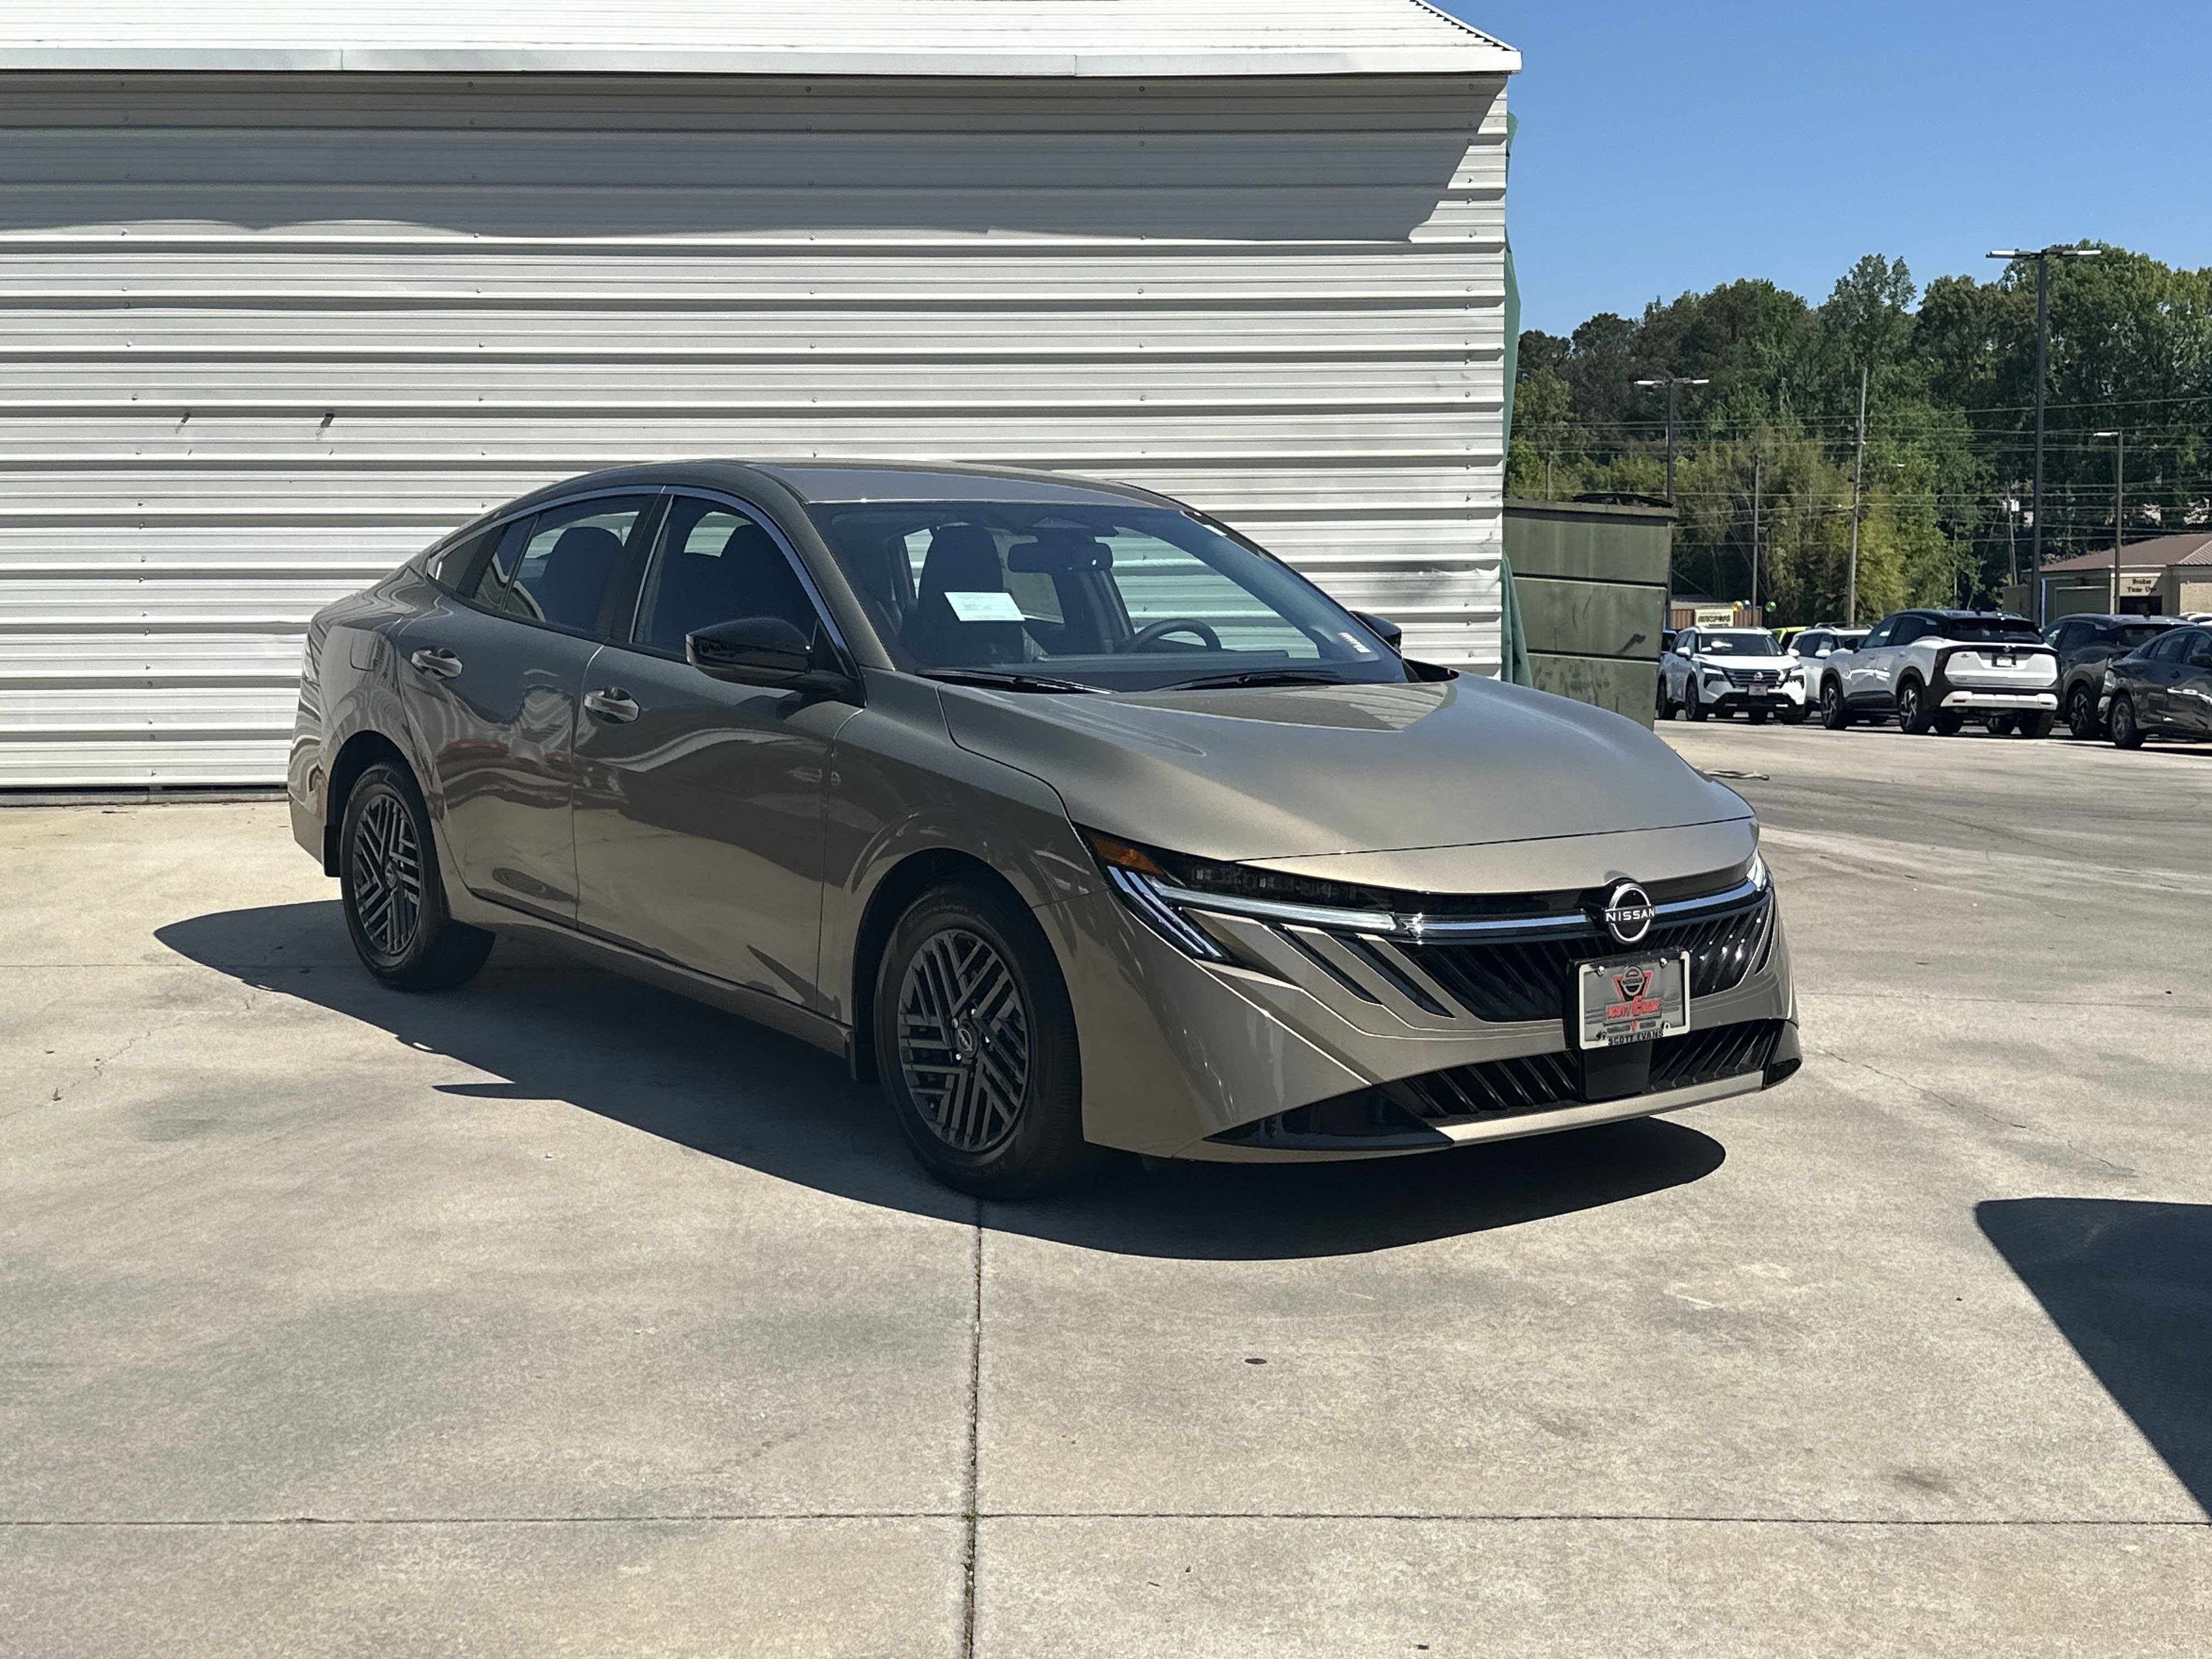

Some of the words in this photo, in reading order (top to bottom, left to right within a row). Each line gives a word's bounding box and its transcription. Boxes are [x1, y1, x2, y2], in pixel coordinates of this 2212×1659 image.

[1605, 908, 1655, 922] NISSAN
[1608, 1034, 1634, 1046] SCOTT
[1637, 1029, 1663, 1041] EVANS
